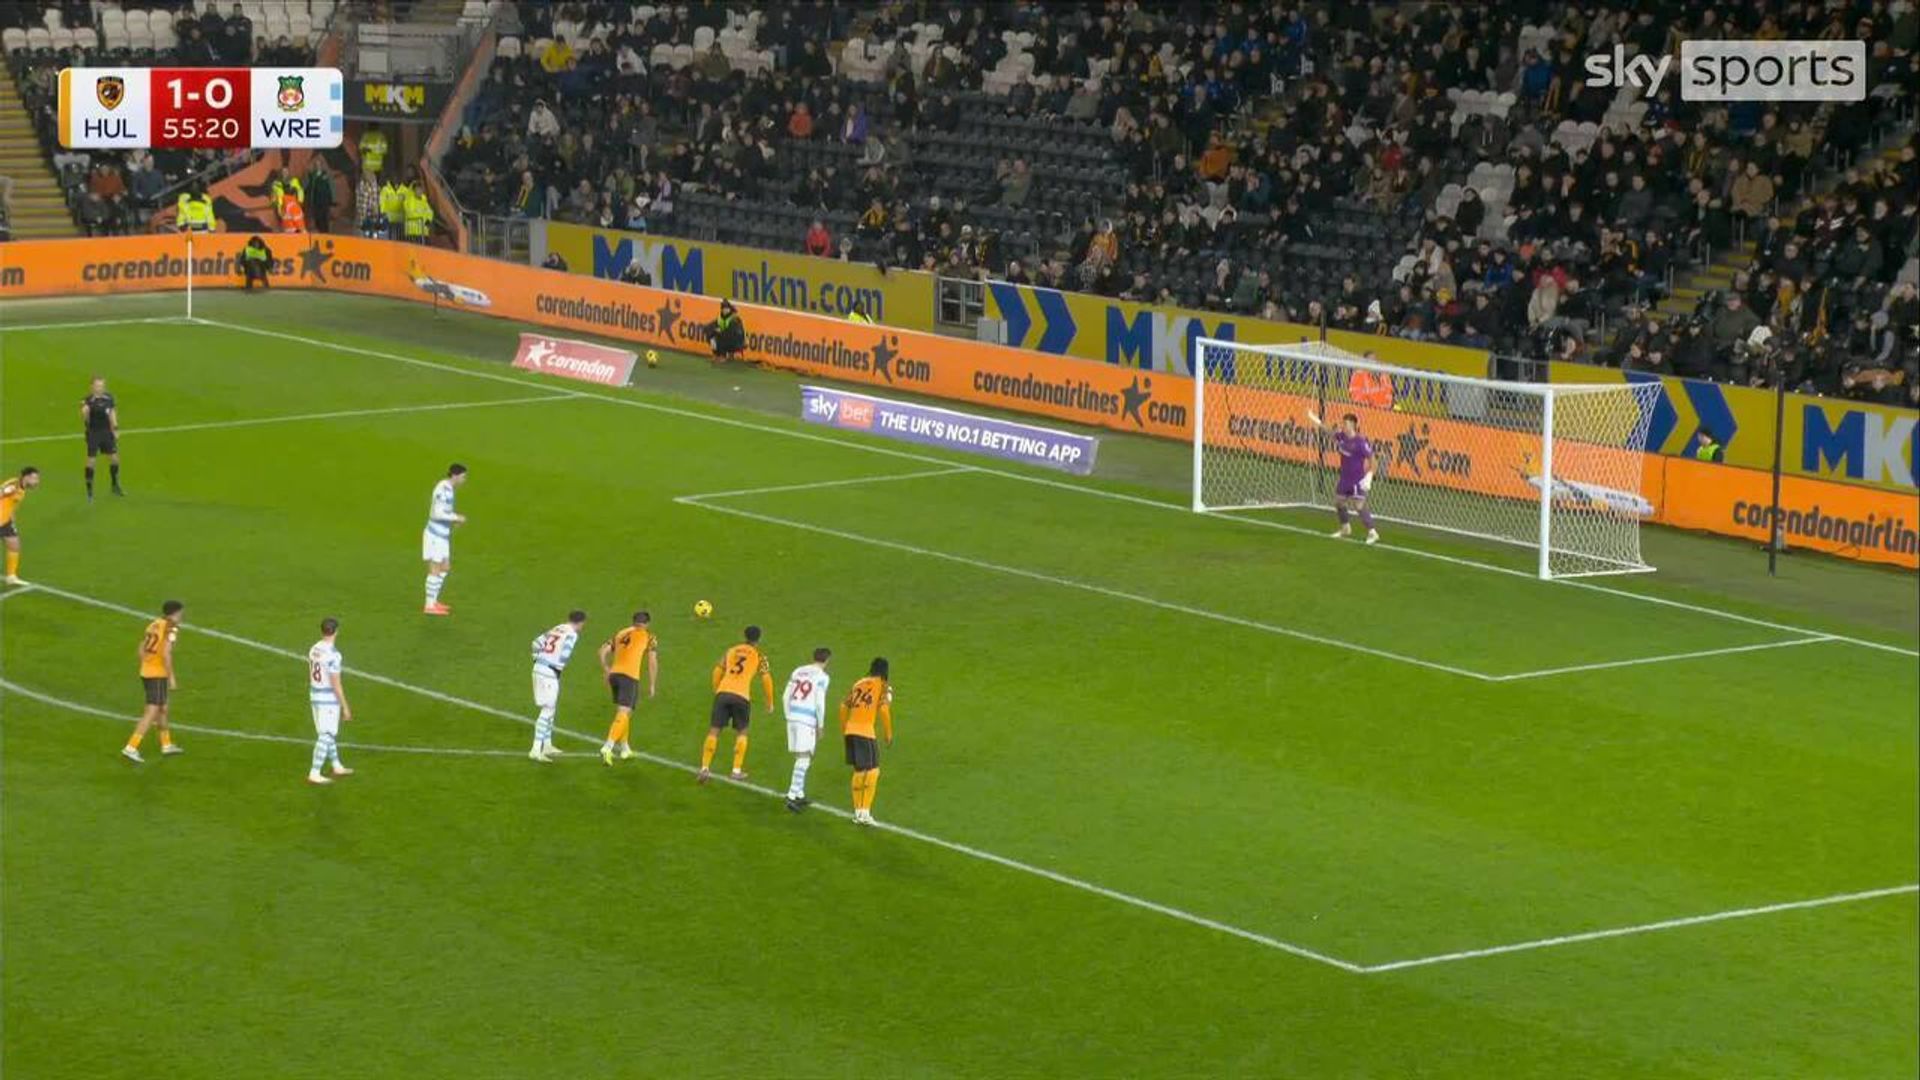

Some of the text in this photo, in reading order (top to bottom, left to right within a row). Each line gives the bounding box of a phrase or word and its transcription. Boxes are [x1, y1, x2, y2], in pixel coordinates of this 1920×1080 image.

[364, 84, 425, 113] MKM
[82, 251, 371, 281] corendonairles com
[593, 235, 703, 296] MKM
[536, 292, 656, 334] corendonairlines
[732, 261, 883, 321] mkm.com
[744, 333, 931, 383] orendonairlines com
[1106, 306, 1236, 383] MKM
[973, 369, 1187, 428] corendonairlines com
[810, 394, 1082, 463] sky bet THE UK'S NO.1 BETTING APP
[1803, 403, 1919, 490] MK
[730, 655, 747, 675] 3
[792, 678, 813, 701] 29
[849, 687, 873, 709] 24
